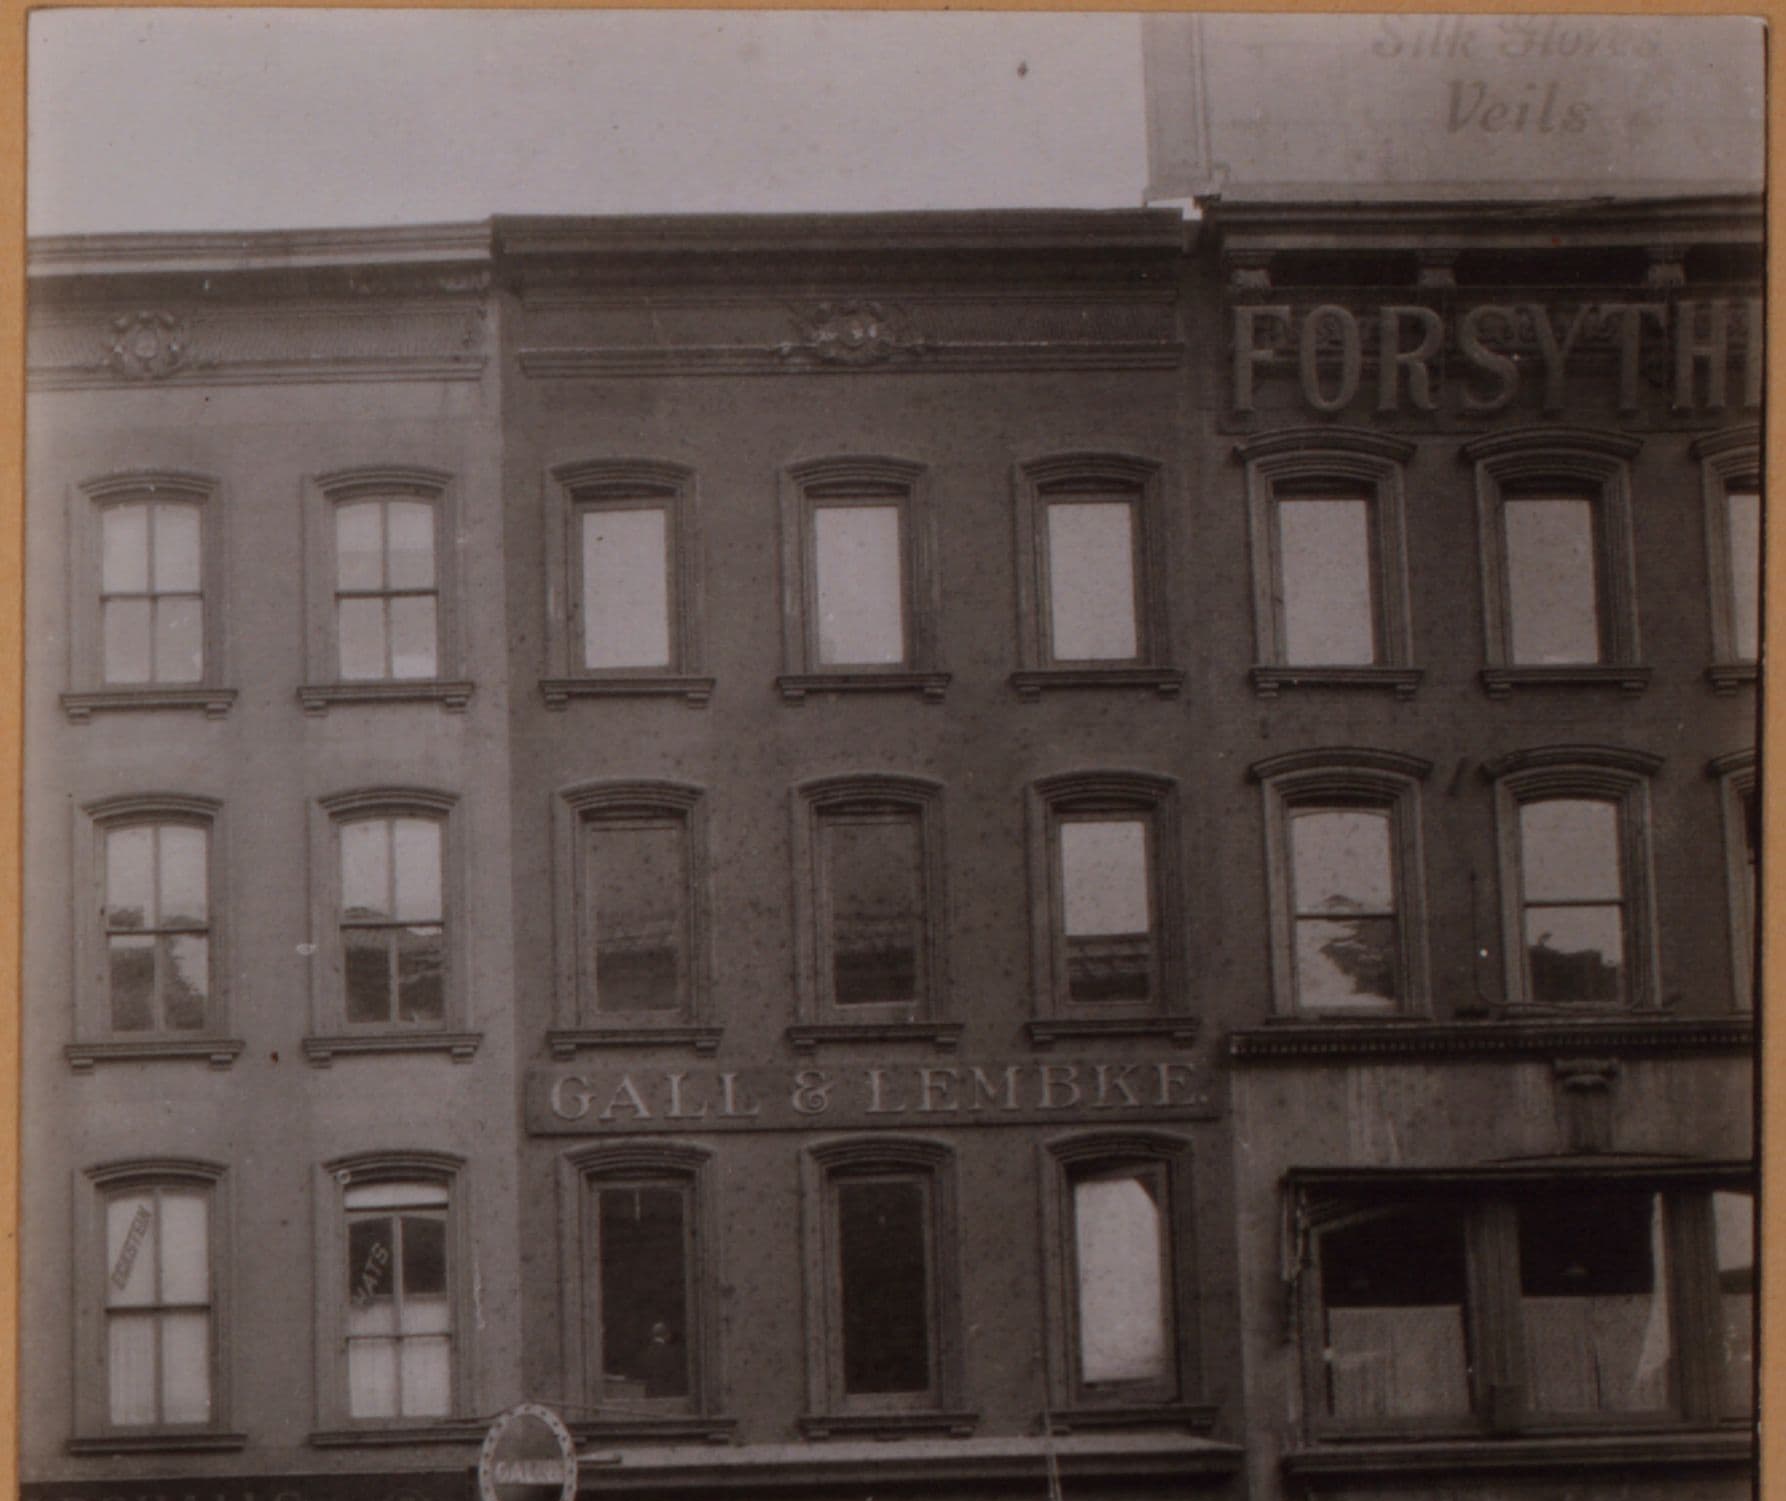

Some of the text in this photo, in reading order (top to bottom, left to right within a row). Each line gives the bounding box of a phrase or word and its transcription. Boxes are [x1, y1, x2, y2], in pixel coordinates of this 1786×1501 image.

[1444, 78, 1593, 134] Veils
[549, 1071, 760, 1123] GALL
[790, 1068, 832, 1115] &
